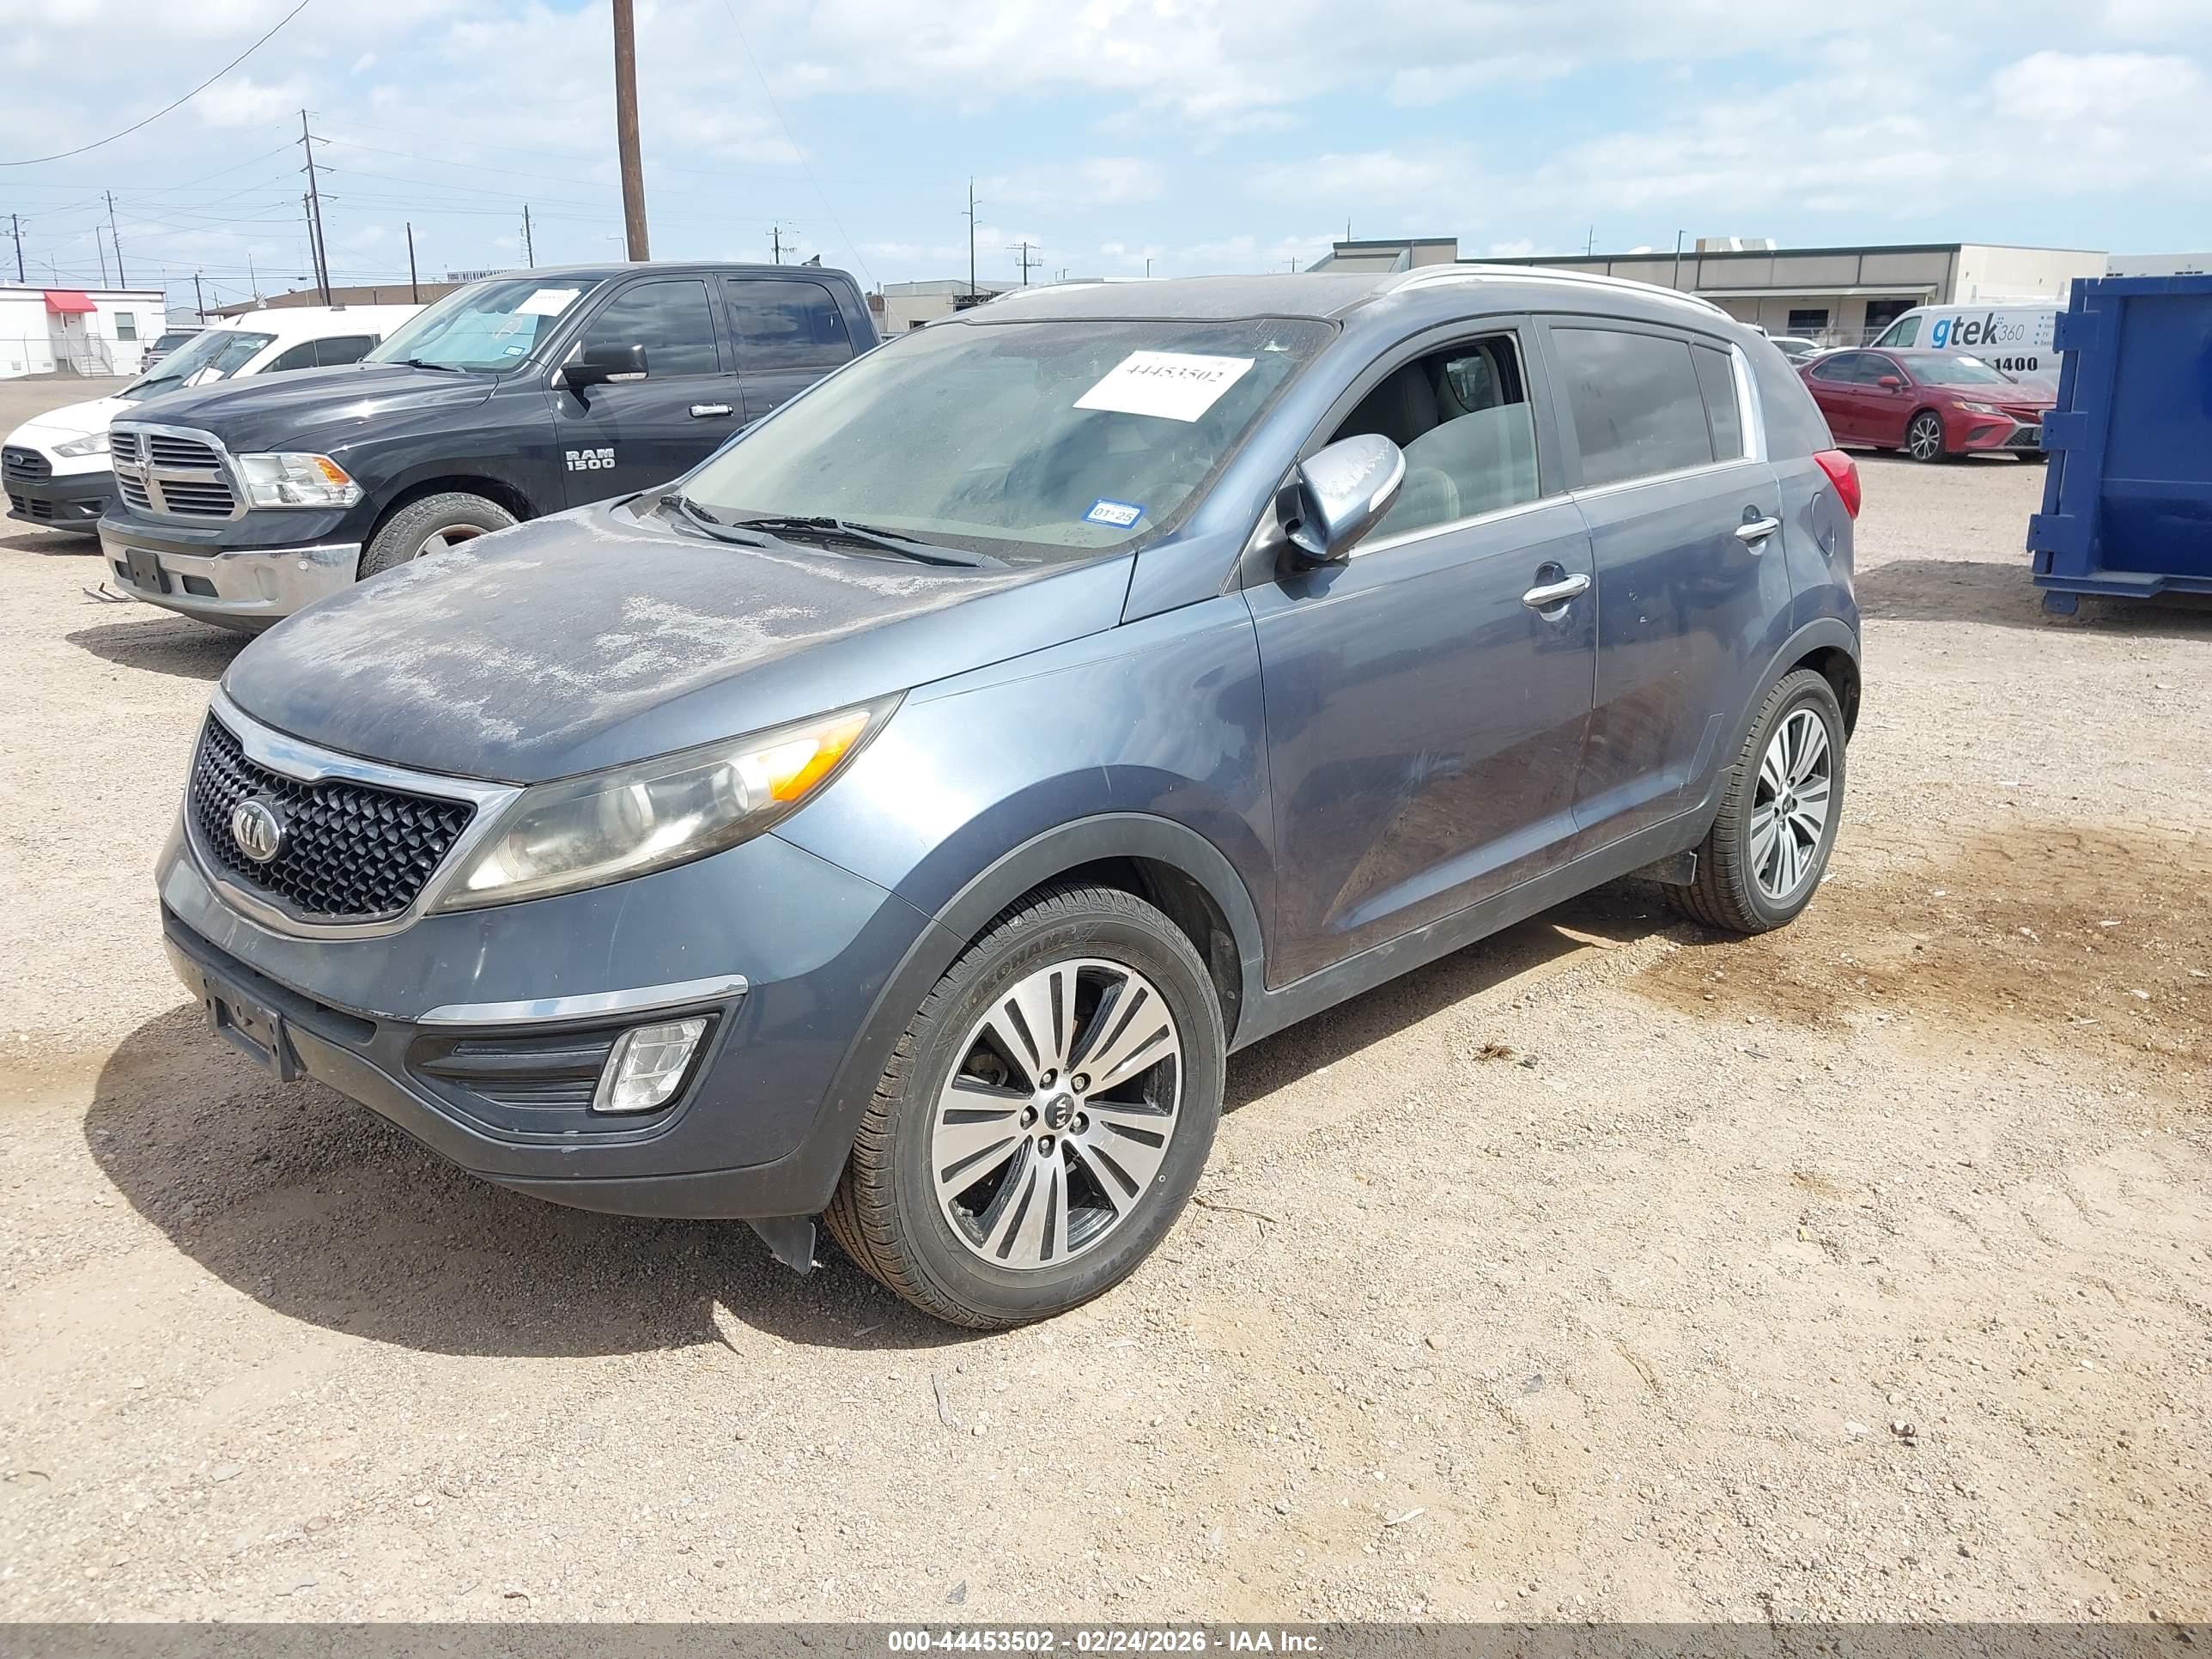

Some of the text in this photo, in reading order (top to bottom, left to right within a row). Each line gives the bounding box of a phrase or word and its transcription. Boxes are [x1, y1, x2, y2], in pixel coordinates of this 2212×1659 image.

[1994, 357, 2038, 371] 1400
[1127, 365, 1224, 382] 44453502
[565, 448, 615, 460] RAM
[567, 459, 616, 471] 1500
[237, 810, 267, 852] KIA
[1056, 1096, 1066, 1127] KIA
